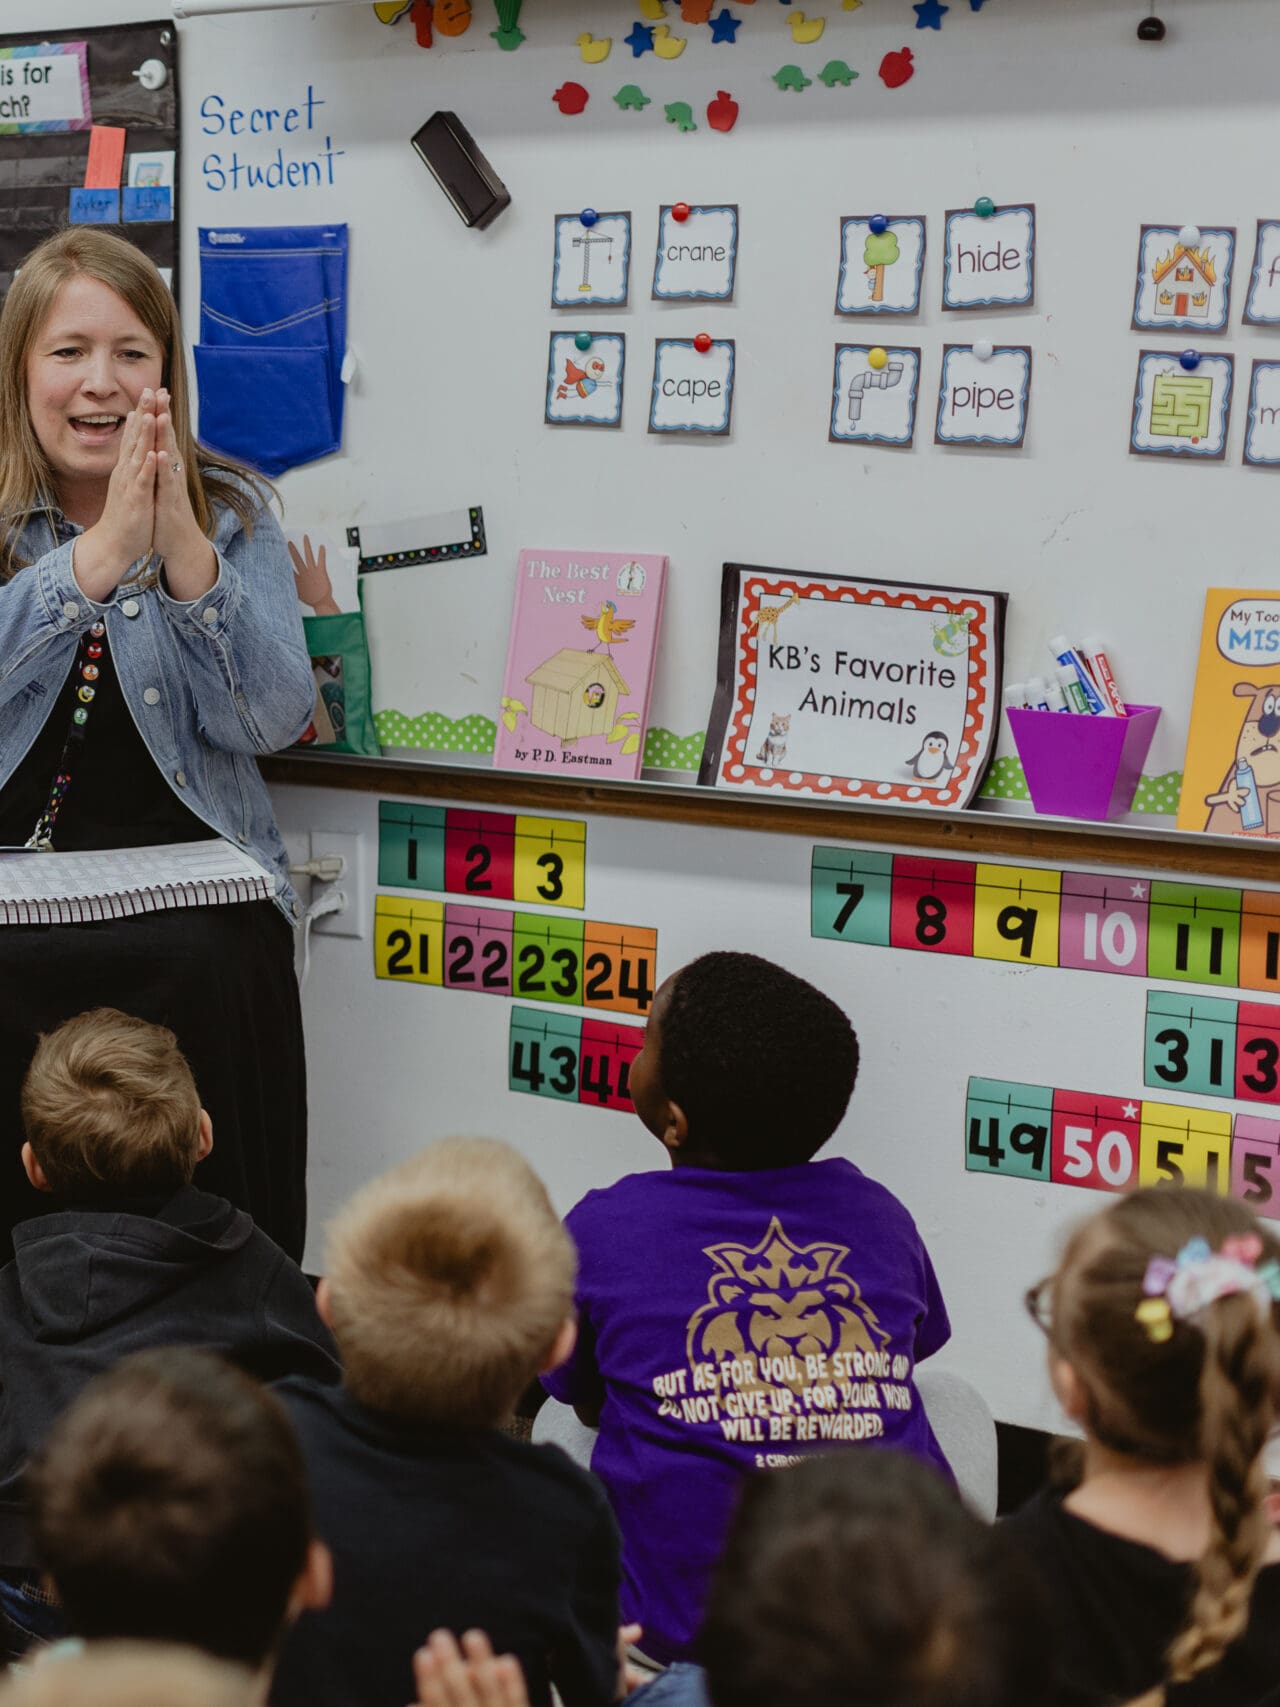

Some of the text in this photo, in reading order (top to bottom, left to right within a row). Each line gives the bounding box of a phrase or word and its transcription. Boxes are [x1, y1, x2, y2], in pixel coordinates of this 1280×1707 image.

[0, 65, 13, 86] is
[23, 62, 52, 85] for
[200, 85, 325, 135] Secret
[203, 136, 345, 191] Student
[666, 245, 726, 262] crane
[957, 240, 1021, 274] hide
[662, 378, 721, 404] cape
[951, 381, 1015, 418] pipe
[527, 560, 610, 580] The Best
[543, 586, 586, 603] Nest
[1230, 609, 1252, 626] My
[769, 645, 956, 689] KB's Favorite
[798, 686, 917, 725] Animals
[514, 749, 528, 761] by
[562, 751, 612, 766] Eastman
[407, 839, 564, 901] 1 2 3
[833, 883, 864, 933] 7
[915, 895, 947, 945] 8
[997, 905, 1038, 958] 9
[1084, 911, 1137, 967] 10
[1176, 923, 1223, 975] 11
[386, 929, 653, 1010] 21 22 23 24
[512, 1041, 577, 1094] 43
[1154, 1028, 1224, 1087] 31
[969, 1117, 1049, 1172] 49
[1063, 1126, 1133, 1186] 50
[1156, 1140, 1219, 1192] 51
[652, 1368, 687, 1397] BUT
[693, 1361, 717, 1391] AS
[720, 1359, 756, 1387] FOR
[759, 1355, 803, 1385] YOU,
[805, 1353, 829, 1379] BE
[832, 1351, 890, 1378] STRONG
[681, 1395, 720, 1424] NOT
[725, 1391, 766, 1419] GIVE
[770, 1388, 801, 1413] UP,
[803, 1385, 838, 1410] FOR
[840, 1382, 882, 1408] YOUR
[720, 1412, 884, 1441] WILL BE REWARDED.
[755, 1453, 765, 1468] 2
